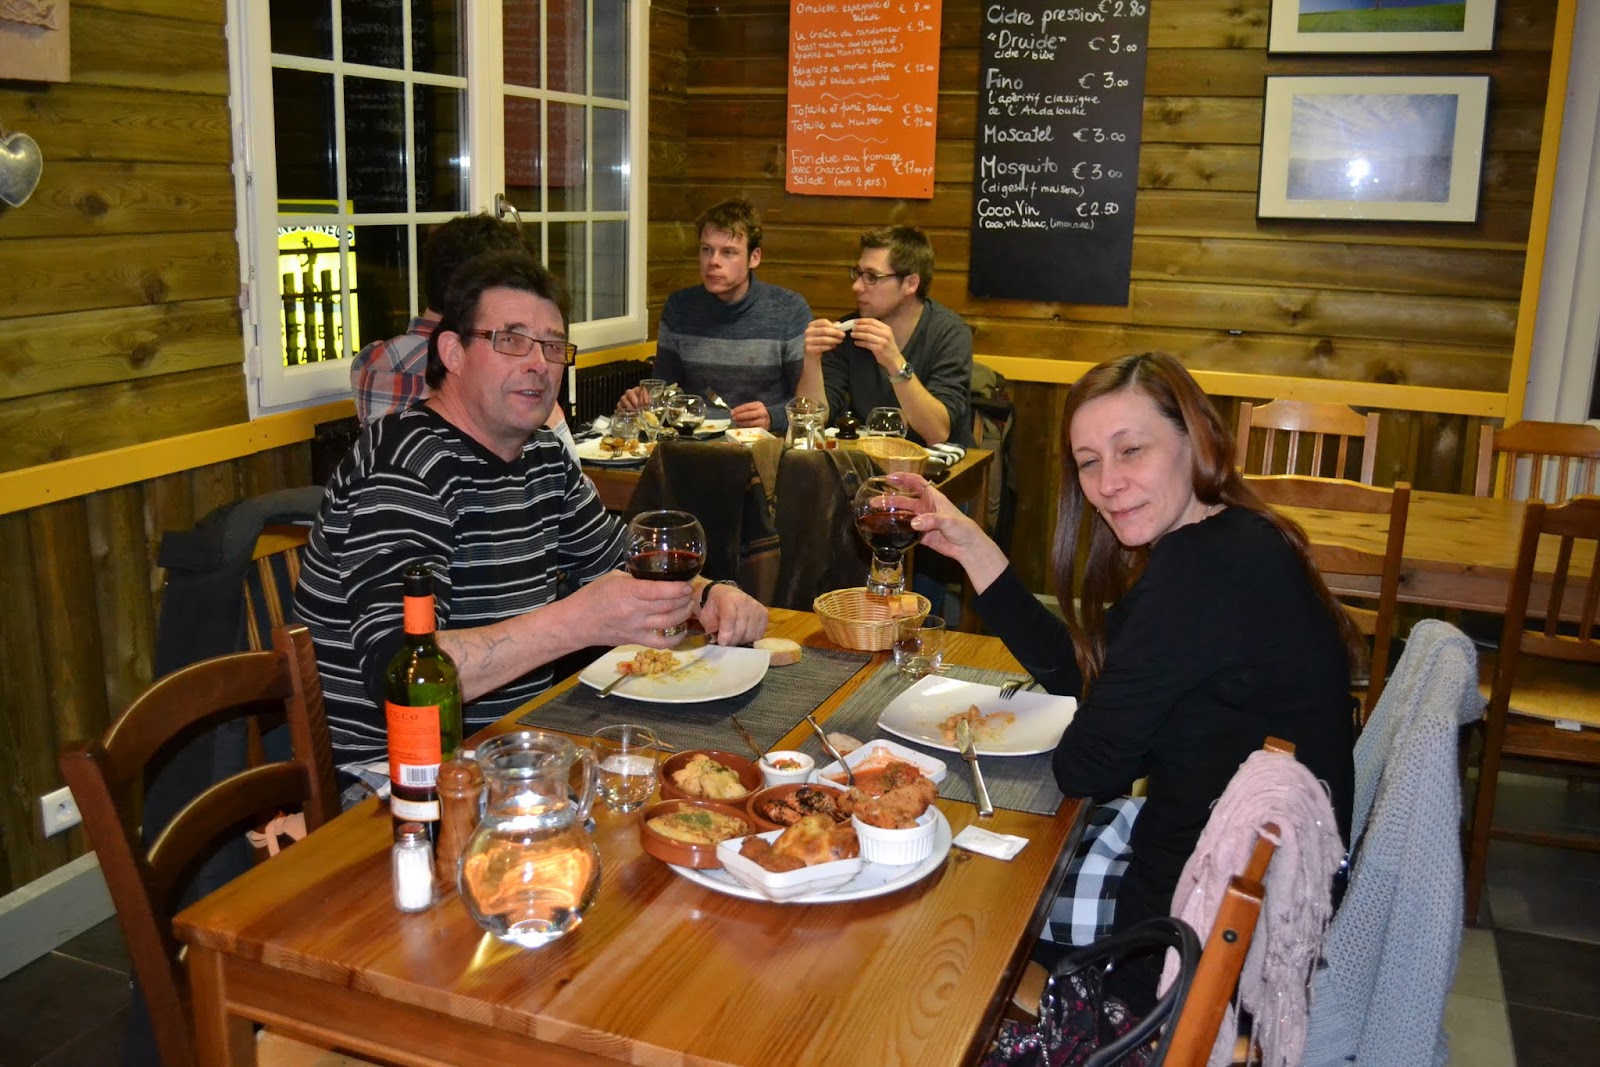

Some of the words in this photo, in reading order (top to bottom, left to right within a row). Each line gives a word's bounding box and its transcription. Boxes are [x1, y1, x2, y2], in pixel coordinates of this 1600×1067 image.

[987, 5, 1034, 26] Cidre
[1041, 8, 1105, 34] pression
[994, 47, 1019, 59] cidre
[985, 67, 1024, 90] Fino
[988, 106, 1001, 116] de
[1044, 94, 1100, 108] classique
[984, 124, 1054, 144] Moscatel
[791, 149, 840, 165] Fondue
[842, 154, 860, 162] au
[861, 148, 903, 169] fromage
[791, 165, 811, 174] avec
[981, 155, 1058, 188] Mosquito
